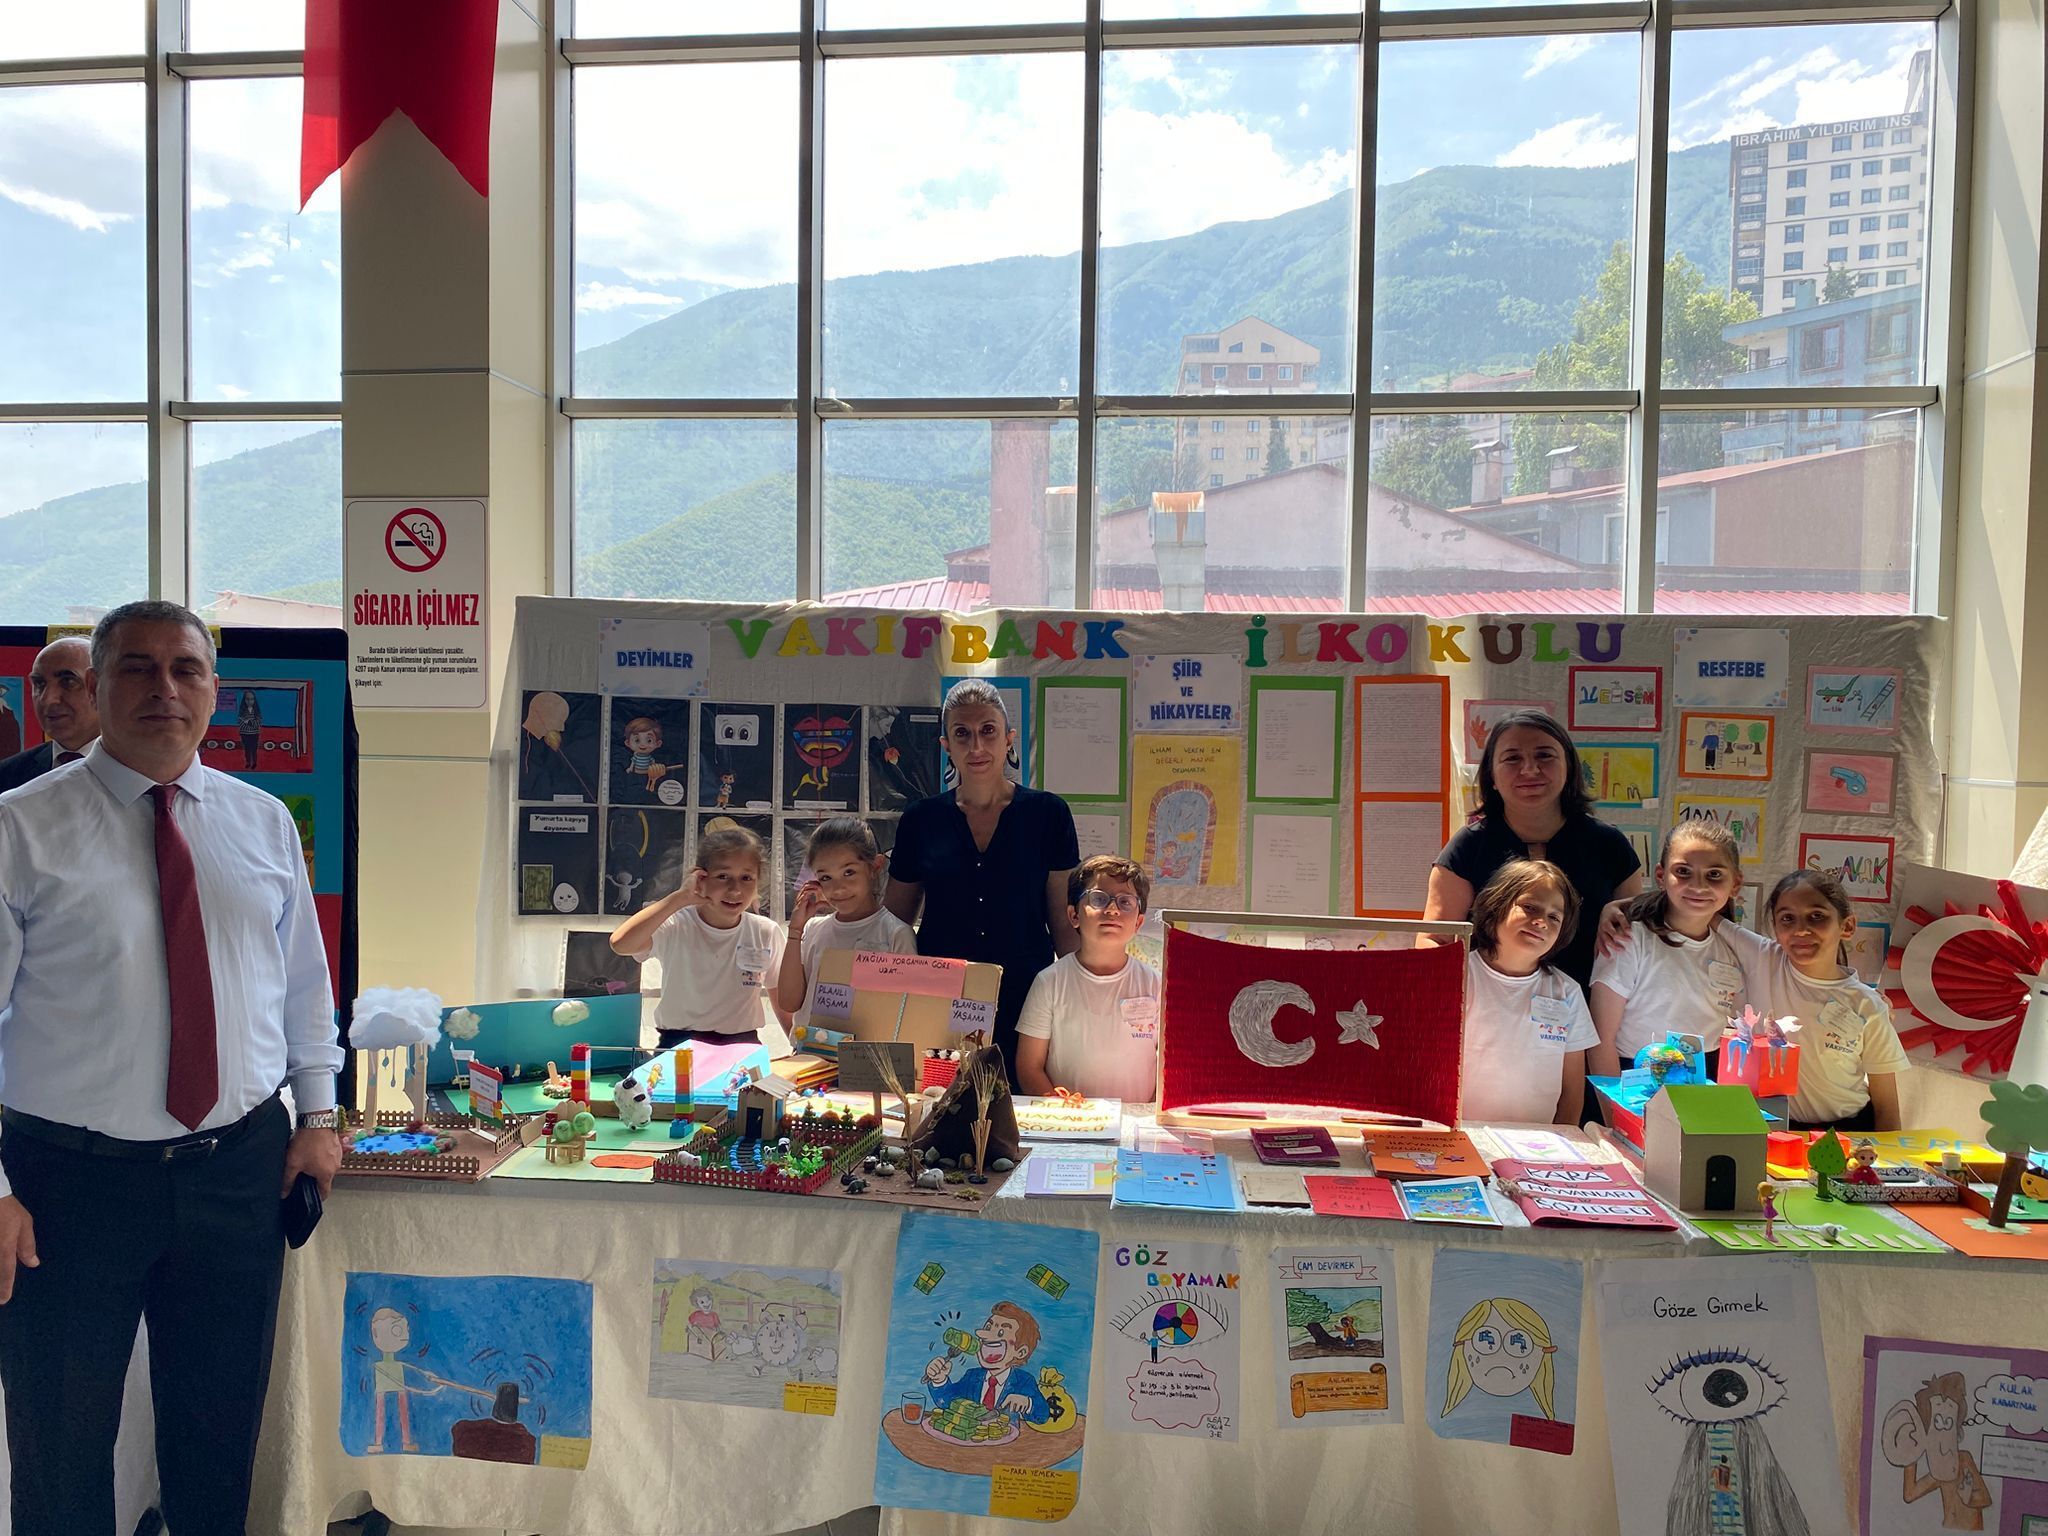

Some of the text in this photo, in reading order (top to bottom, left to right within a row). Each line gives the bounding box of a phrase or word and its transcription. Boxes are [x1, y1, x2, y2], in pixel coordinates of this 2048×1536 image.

[1735, 113, 1912, 147] IBRAHIM YILDIRIM INS
[354, 588, 480, 630] SİGARA İÇİLMEZ
[617, 648, 694, 669] DEYİMLER
[1172, 658, 1202, 681] ŞİİR
[1698, 661, 1766, 678] RESFEBE
[1180, 686, 1194, 697] VE
[1150, 702, 1232, 720] HİKAYELER
[534, 815, 586, 824] Yumurta kapıya
[817, 997, 849, 1009] YAŞAMA
[952, 1010, 985, 1023] YAŞAMA
[1525, 1167, 1610, 1181] KARA
[1115, 1244, 1169, 1267] GÖZ
[1147, 1272, 1240, 1289] BOYAMAK
[1653, 1292, 1769, 1318] Göze Girmek
[1999, 1382, 2033, 1396] KULAK
[1010, 1467, 1056, 1478] PARA YEMEK
